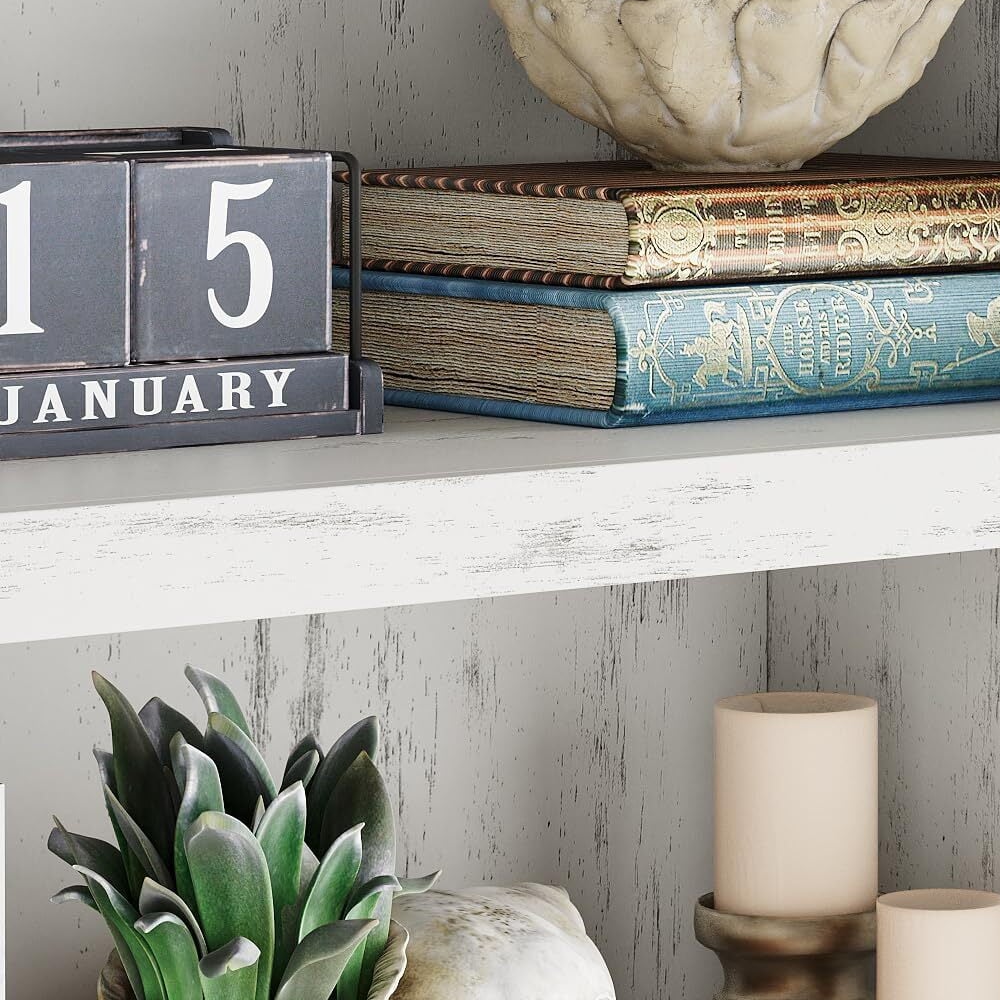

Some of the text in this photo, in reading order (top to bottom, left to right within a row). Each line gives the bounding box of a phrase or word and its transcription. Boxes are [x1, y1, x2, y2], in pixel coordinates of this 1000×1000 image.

[0, 178, 274, 335] 1 5
[794, 299, 815, 377] HORSE
[831, 292, 852, 377] RIDER
[0, 367, 296, 426] JANUARY
